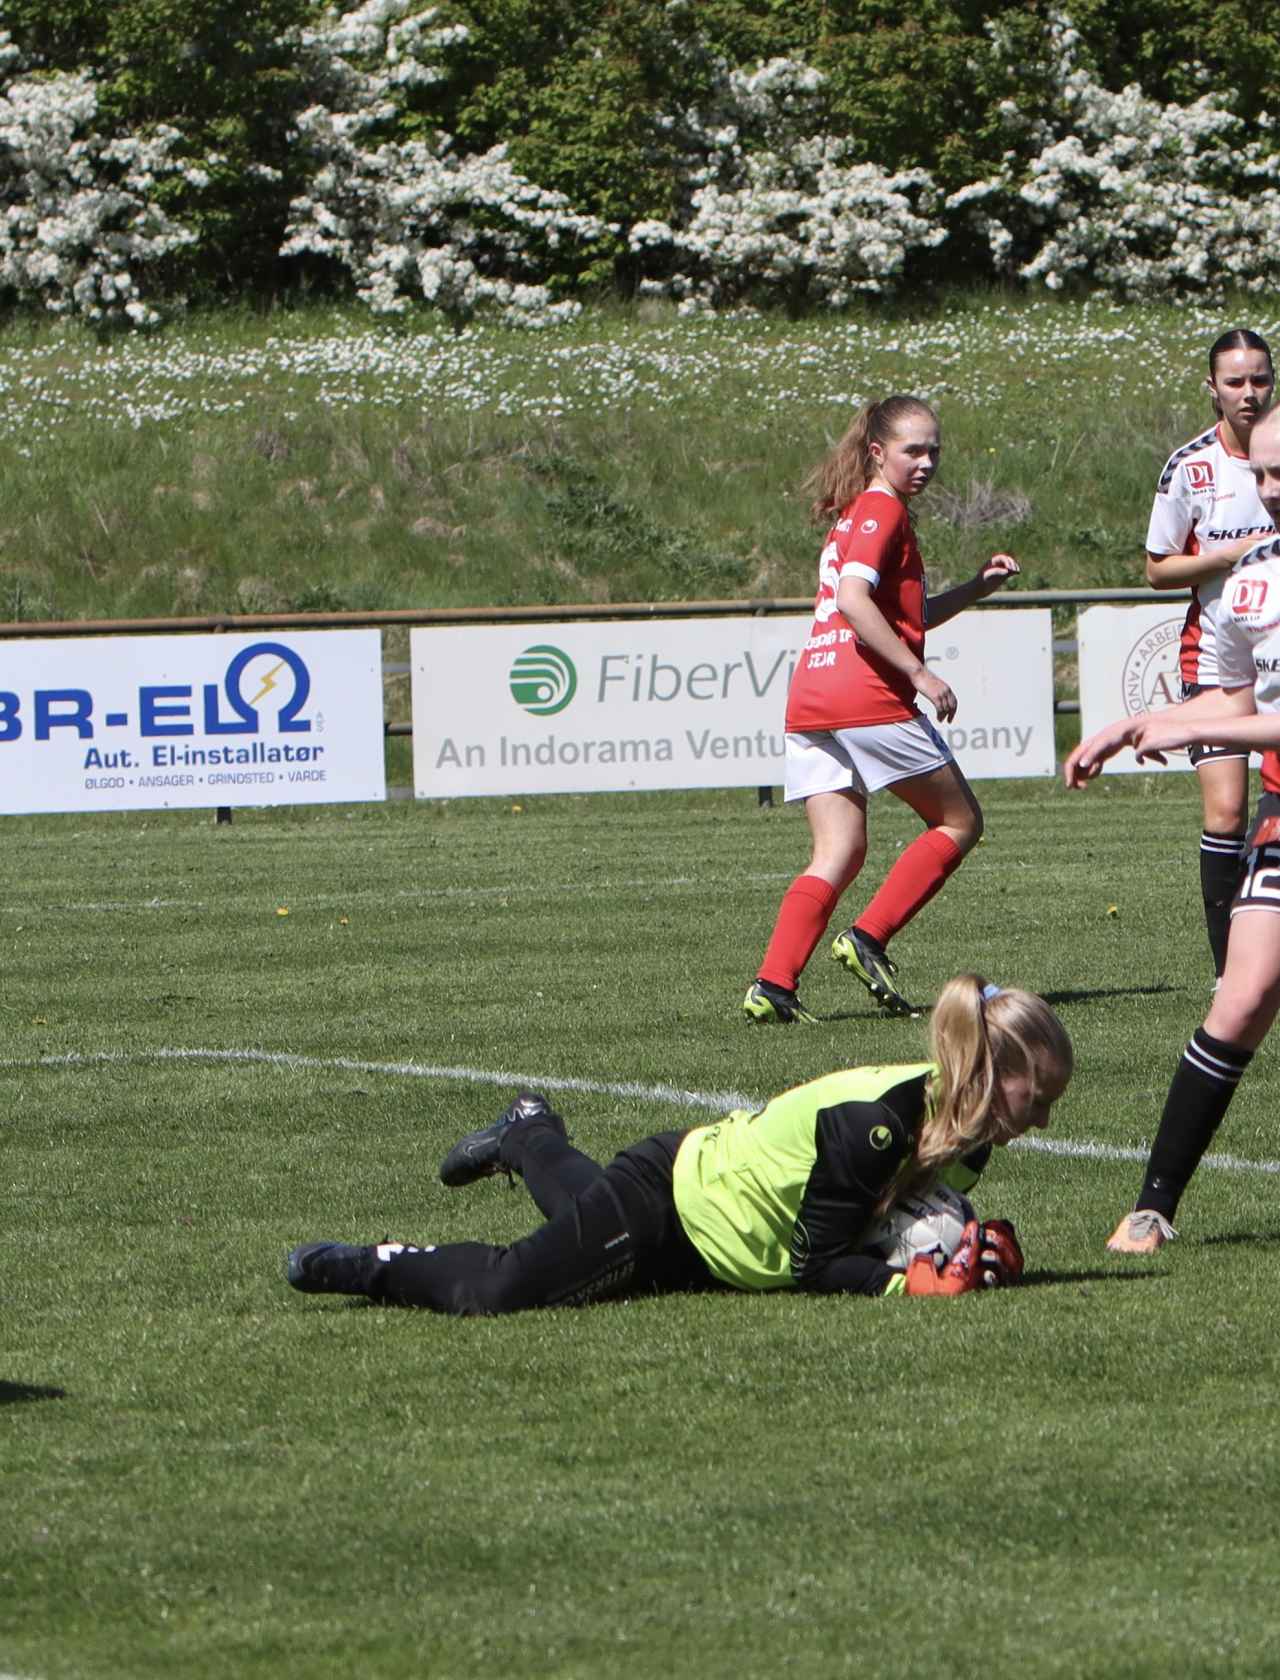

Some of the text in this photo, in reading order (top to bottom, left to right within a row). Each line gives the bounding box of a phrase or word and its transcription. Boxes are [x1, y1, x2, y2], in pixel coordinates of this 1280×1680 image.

[84, 742, 324, 769] Aut. El-installatør
[436, 738, 485, 768] An
[501, 735, 673, 766] Indorama
[138, 775, 194, 787] ANSAGER
[208, 772, 274, 785] GRINDSTED
[287, 770, 326, 783] VARDE
